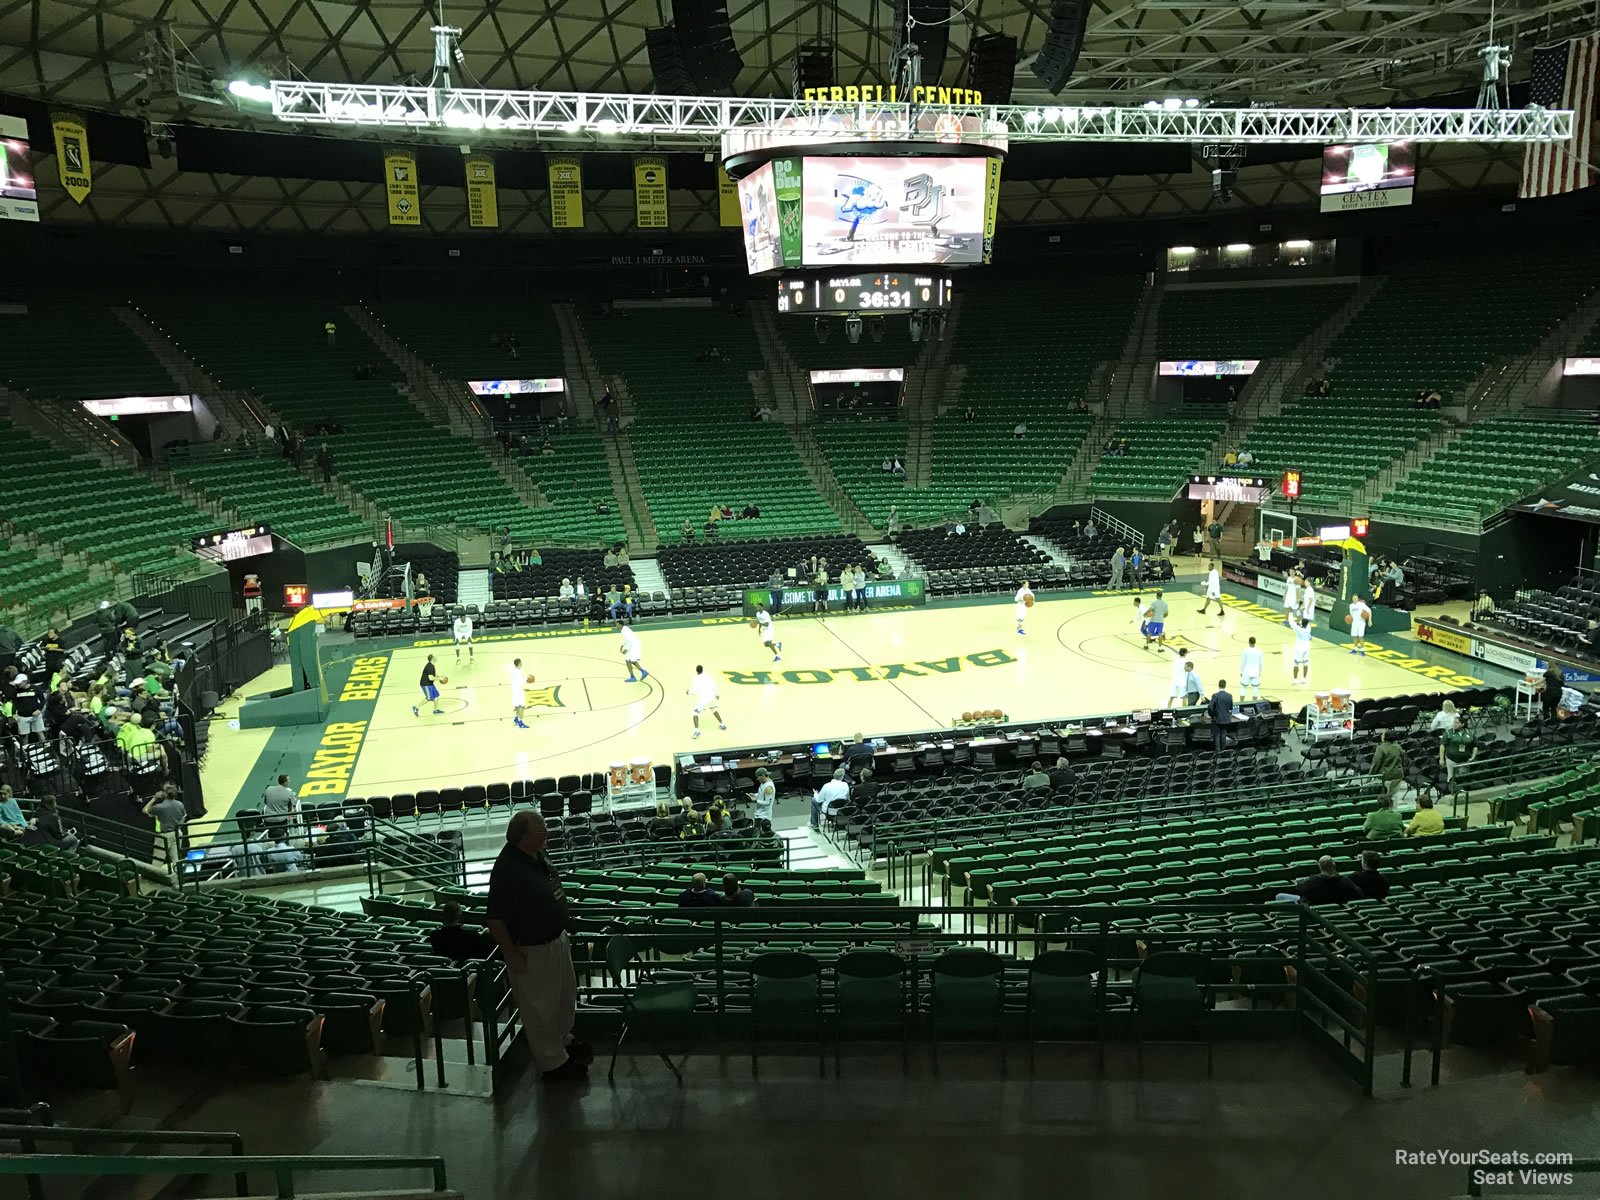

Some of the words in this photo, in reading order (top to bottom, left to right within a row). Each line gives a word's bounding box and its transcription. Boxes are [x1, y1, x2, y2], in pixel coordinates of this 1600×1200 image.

[913, 85, 982, 107] CENTER
[775, 160, 793, 173] DO
[65, 176, 89, 188] 2000
[776, 176, 801, 190] DEW
[1342, 190, 1388, 204] CEN-TEX
[1360, 200, 1389, 208] SYSTEMS
[611, 256, 633, 264] PAUL
[643, 256, 672, 264] MEYER
[675, 255, 705, 264] ARENA
[830, 278, 861, 287] BAYLOR
[874, 278, 881, 286] 4
[891, 278, 899, 286] 4
[835, 288, 846, 303] 0
[859, 291, 911, 308] 36:31
[921, 287, 930, 302] 0
[1206, 491, 1250, 502] BASKETBALL
[769, 591, 806, 606] WLCOME
[876, 585, 902, 598] ARENA
[722, 648, 1018, 686] BAYLOR
[1340, 641, 1485, 687] BEARS
[338, 655, 388, 702] BEARS
[297, 719, 368, 798] BAYLOR
